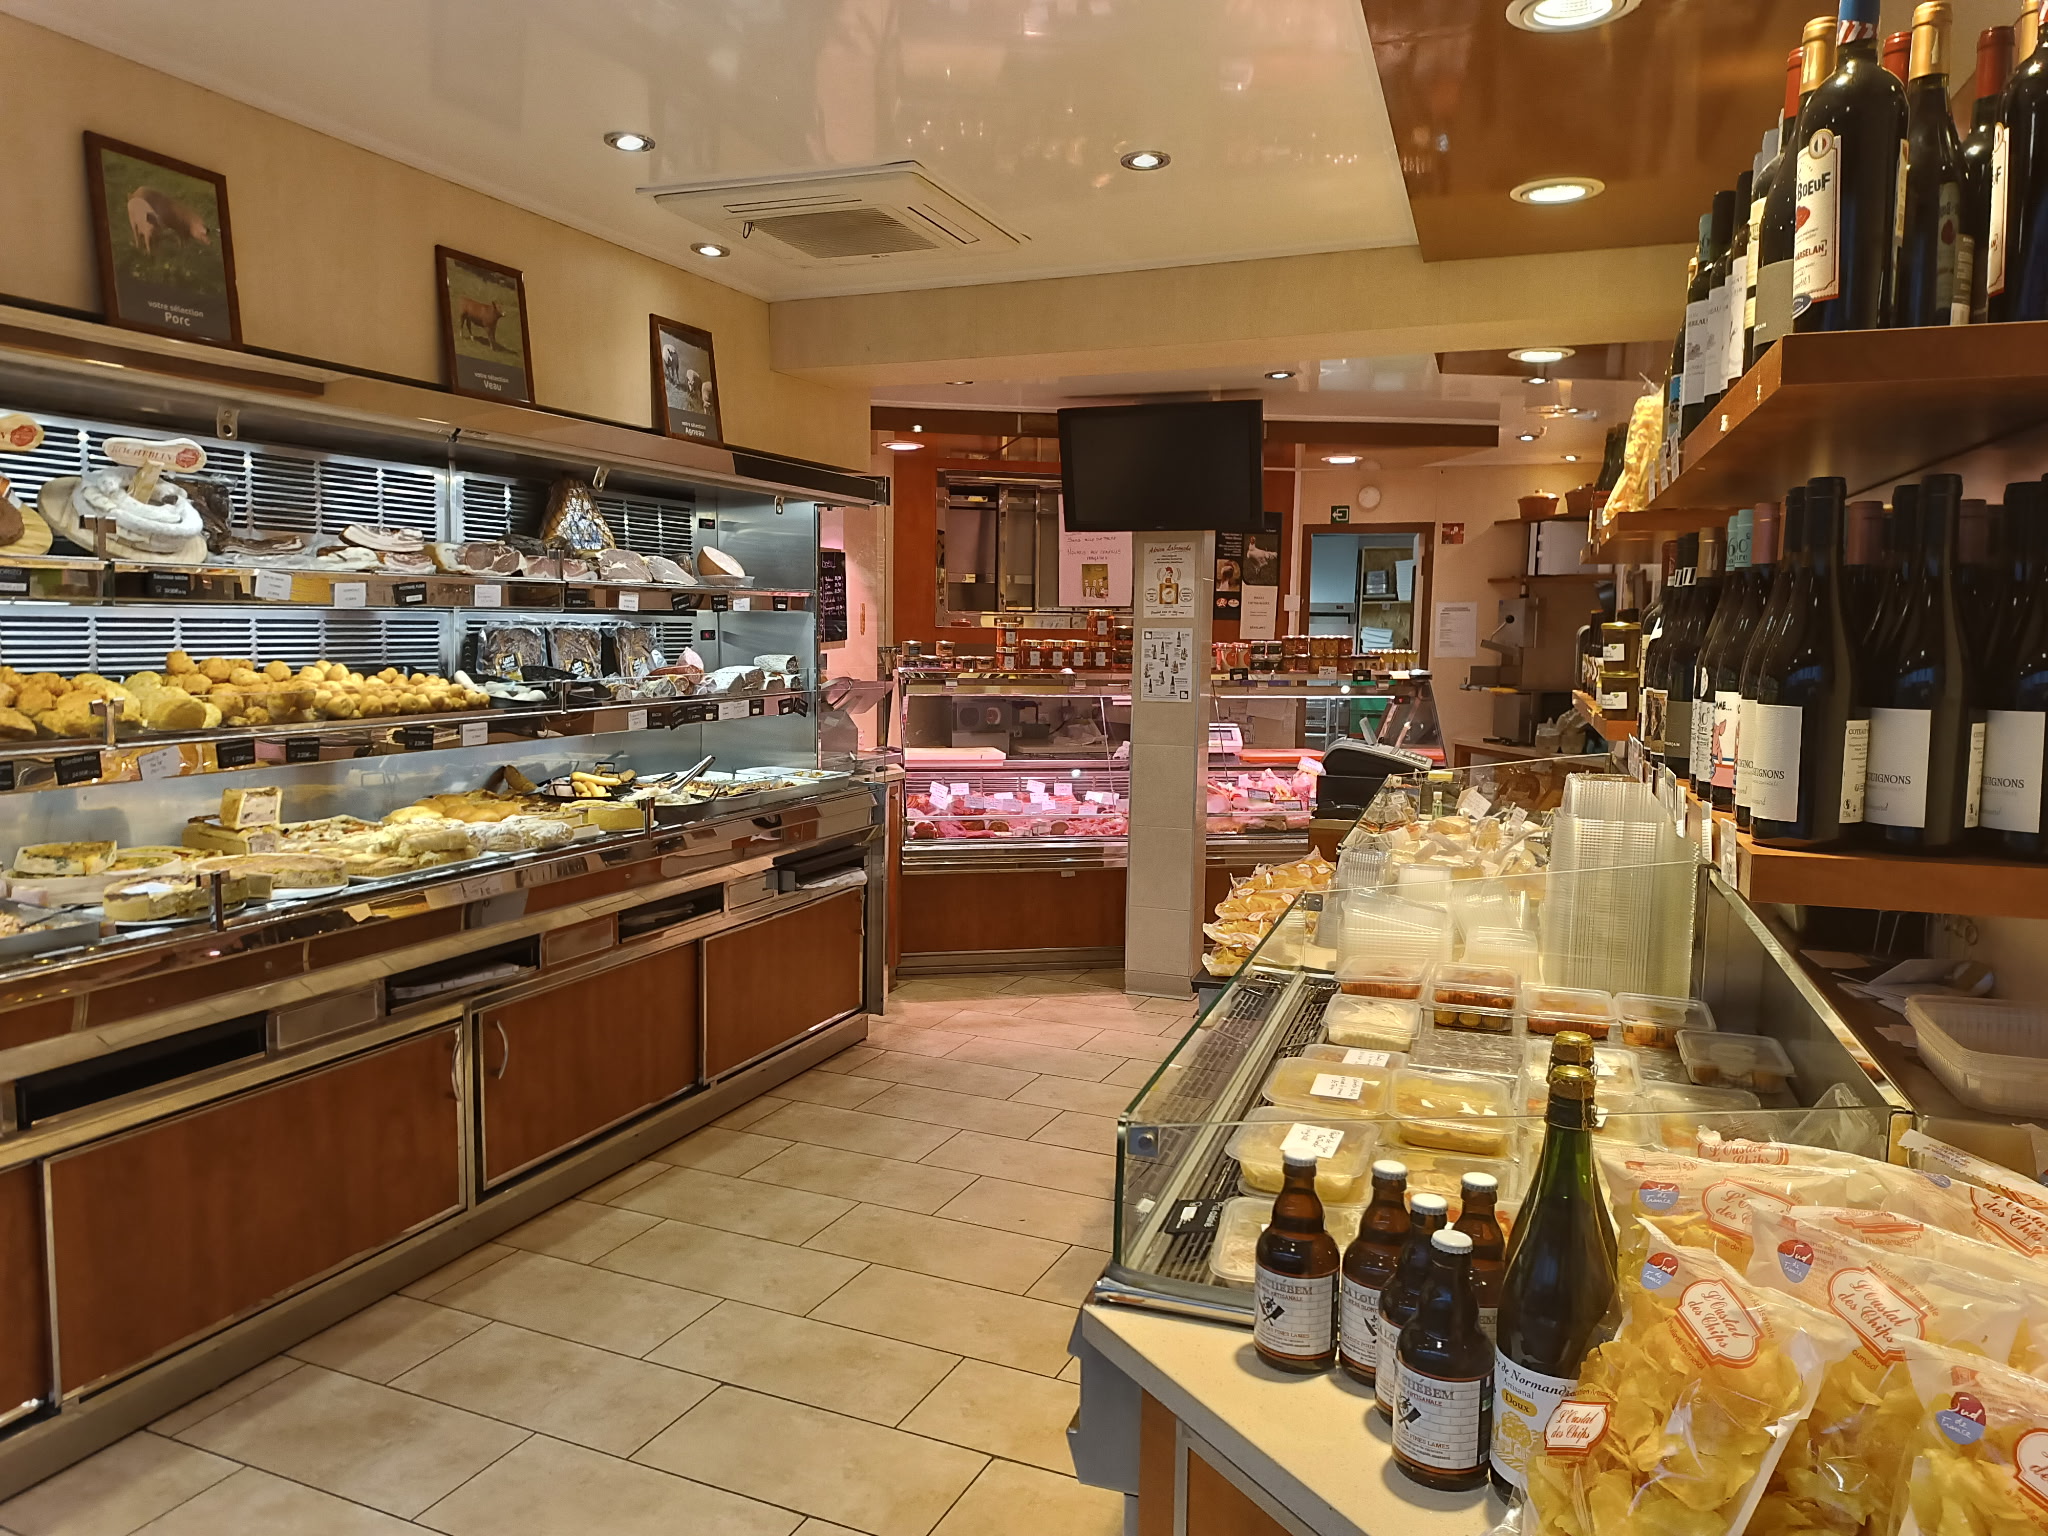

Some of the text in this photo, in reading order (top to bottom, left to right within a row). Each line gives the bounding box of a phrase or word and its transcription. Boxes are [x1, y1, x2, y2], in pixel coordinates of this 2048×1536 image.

[164, 311, 191, 327] Porc
[483, 379, 502, 391] Veau
[685, 427, 705, 437] Agneau
[1649, 1184, 1678, 1192] Sud
[1645, 1196, 1673, 1206] France
[1982, 1201, 2006, 1218] des
[1715, 1205, 1737, 1221] des
[1785, 1244, 1813, 1263] Sud
[1652, 1257, 1677, 1273] Sud
[1784, 1261, 1803, 1277] France
[1643, 1270, 1662, 1285] France
[1867, 1259, 1939, 1317] Fabrication Artisanale
[1355, 1289, 1377, 1306] LOU
[1850, 1279, 1912, 1328] L'Oustal
[1701, 1290, 1750, 1338] L'Oustal
[1837, 1291, 1895, 1344] des Chips
[1687, 1300, 1728, 1348] des Chips
[1851, 1349, 1879, 1371] ournesol
[1401, 1374, 1455, 1401] CHÉBEM
[1503, 1377, 1535, 1400] Artisanal
[1504, 1392, 1531, 1414] Doux
[1946, 1396, 1983, 1421] Sud
[1555, 1408, 1600, 1425] L'Oustal
[1955, 1418, 1968, 1429] de
[1550, 1425, 1591, 1444] des Chips
[1941, 1415, 1972, 1440] France
[1409, 1433, 1427, 1446] FINES
[1427, 1441, 1450, 1450] LAMES
